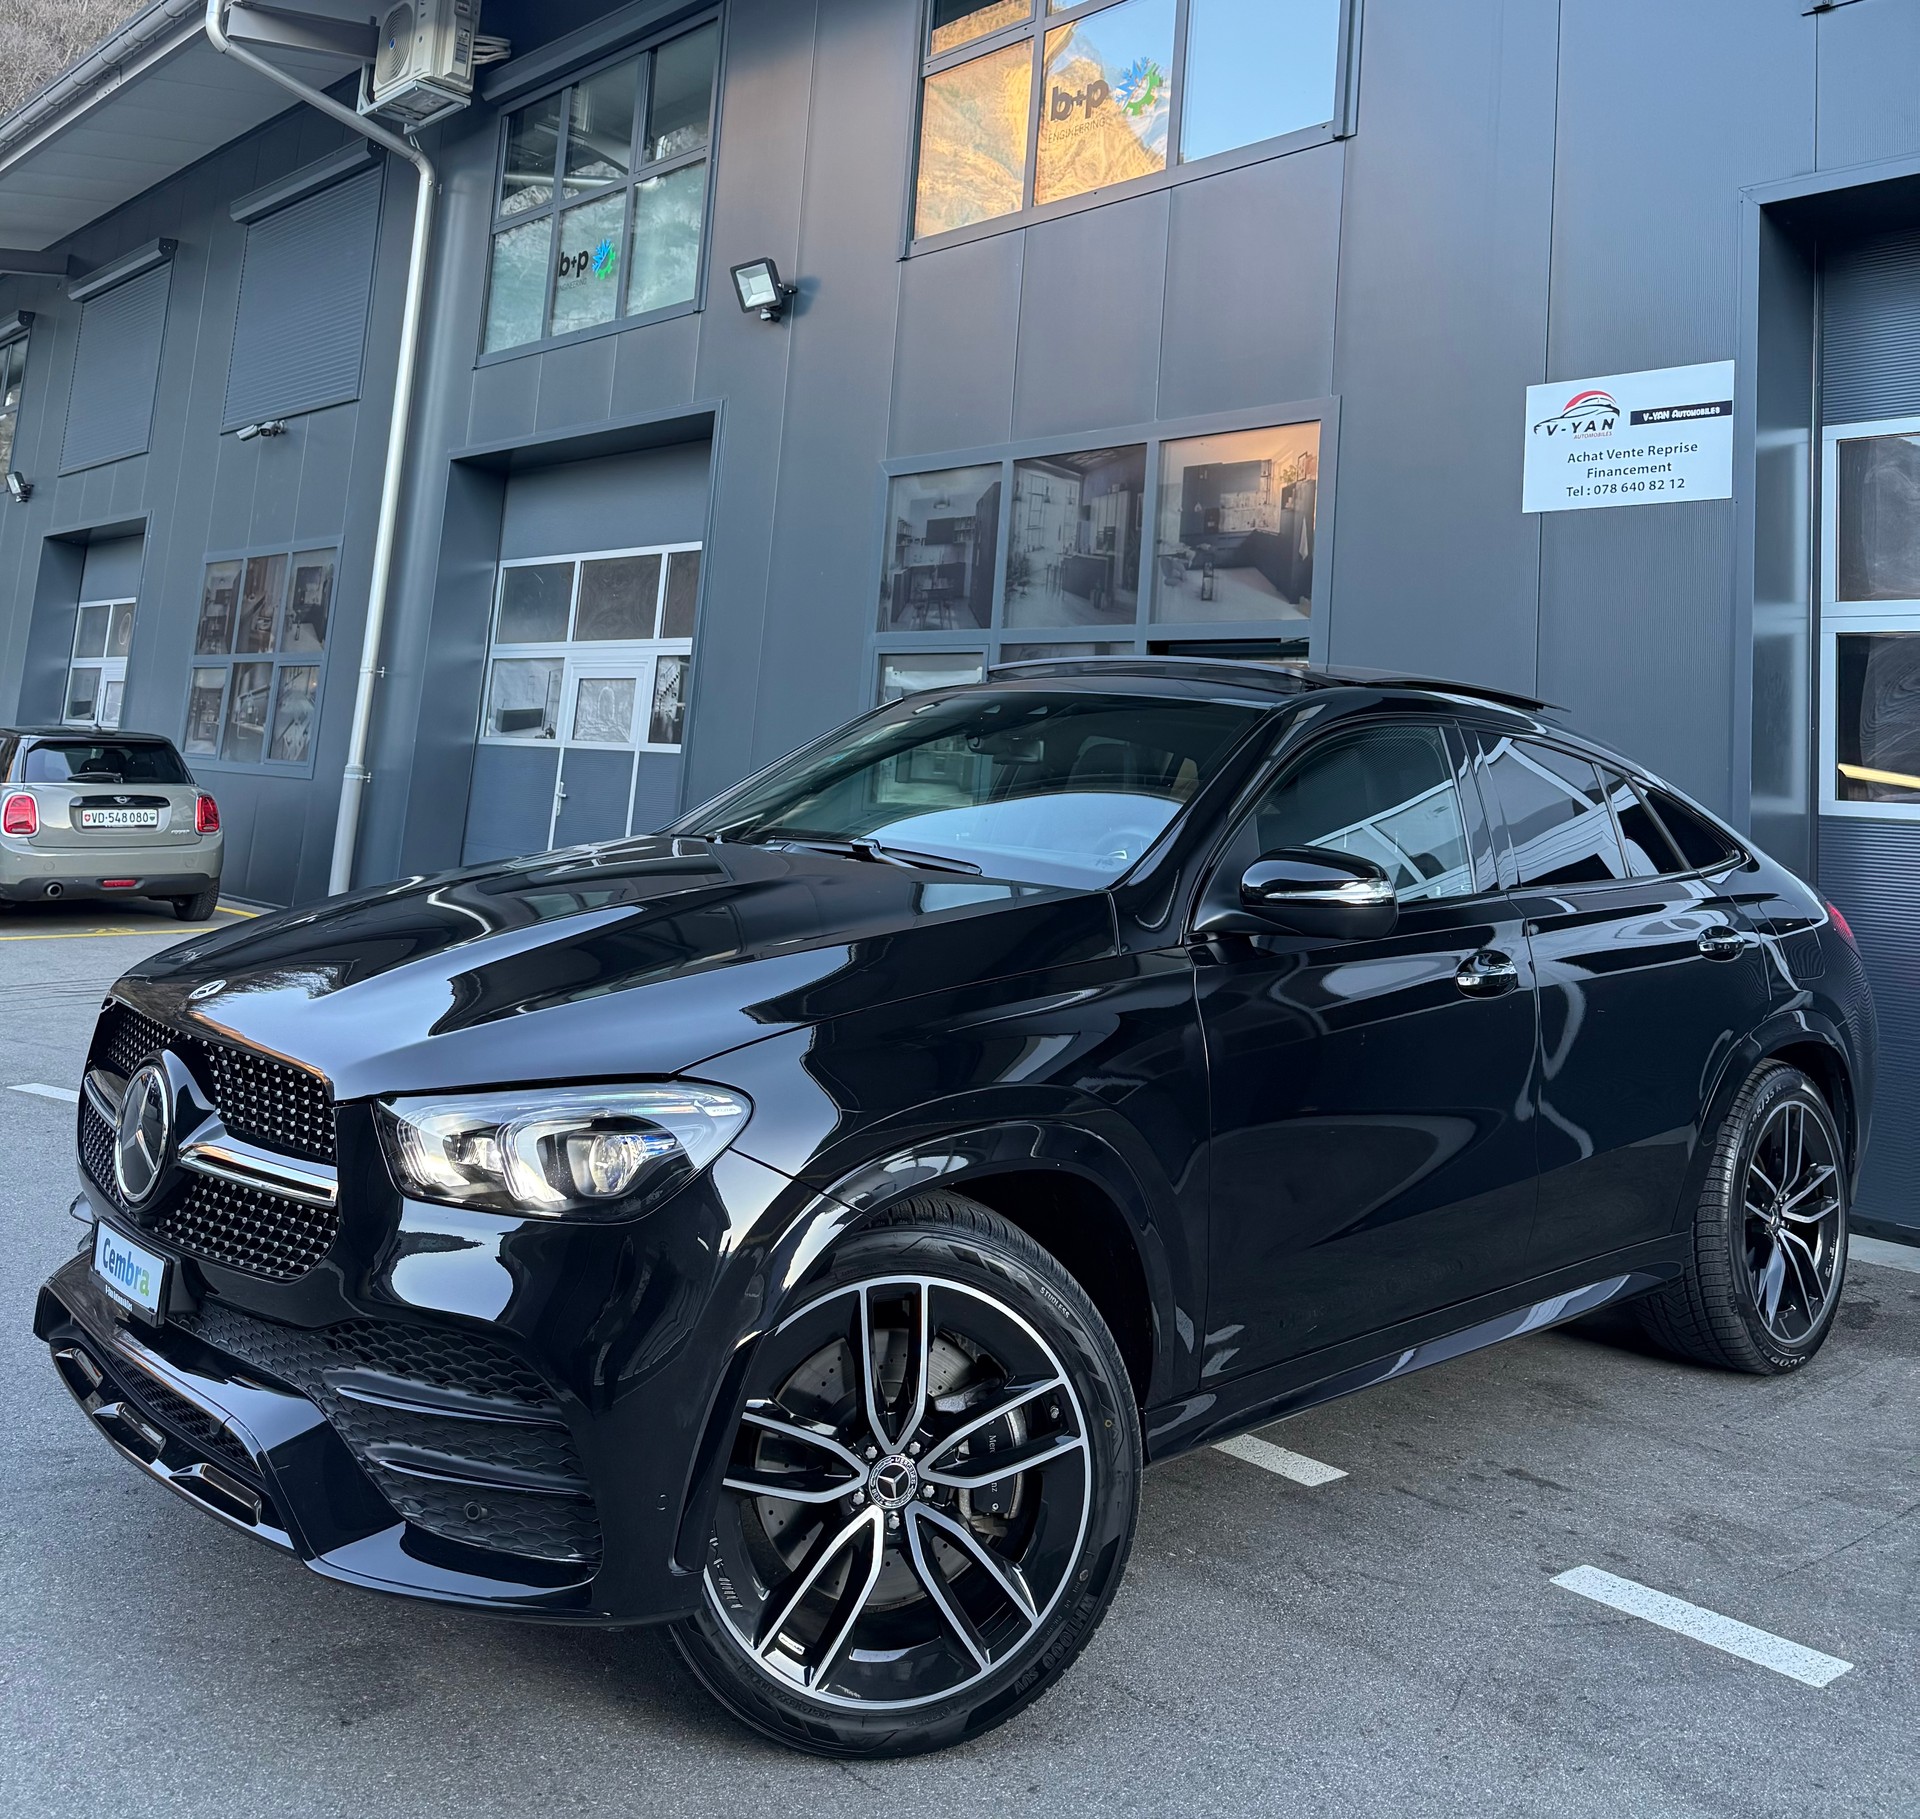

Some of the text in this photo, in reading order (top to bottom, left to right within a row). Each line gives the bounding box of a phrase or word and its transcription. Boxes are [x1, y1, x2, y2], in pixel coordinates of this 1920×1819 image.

[1050, 79, 1110, 122] b+p
[1047, 117, 1106, 143] ENGINEERING
[559, 250, 589, 278] b+p
[1546, 418, 1615, 437] V-YAN
[1643, 410, 1670, 421] V-YAN
[1573, 431, 1613, 440] AUTOMOBILES
[1567, 442, 1699, 464] Achat Vente Reprise
[1586, 462, 1673, 479] Financement
[1593, 482, 1618, 495] 078
[1621, 480, 1646, 493] 640
[1648, 479, 1665, 491] 82
[1669, 478, 1685, 489] 12
[103, 1237, 150, 1297] Cembra
[1040, 1286, 1070, 1319] STUDLESS
[1013, 1666, 1040, 1696] SUV
